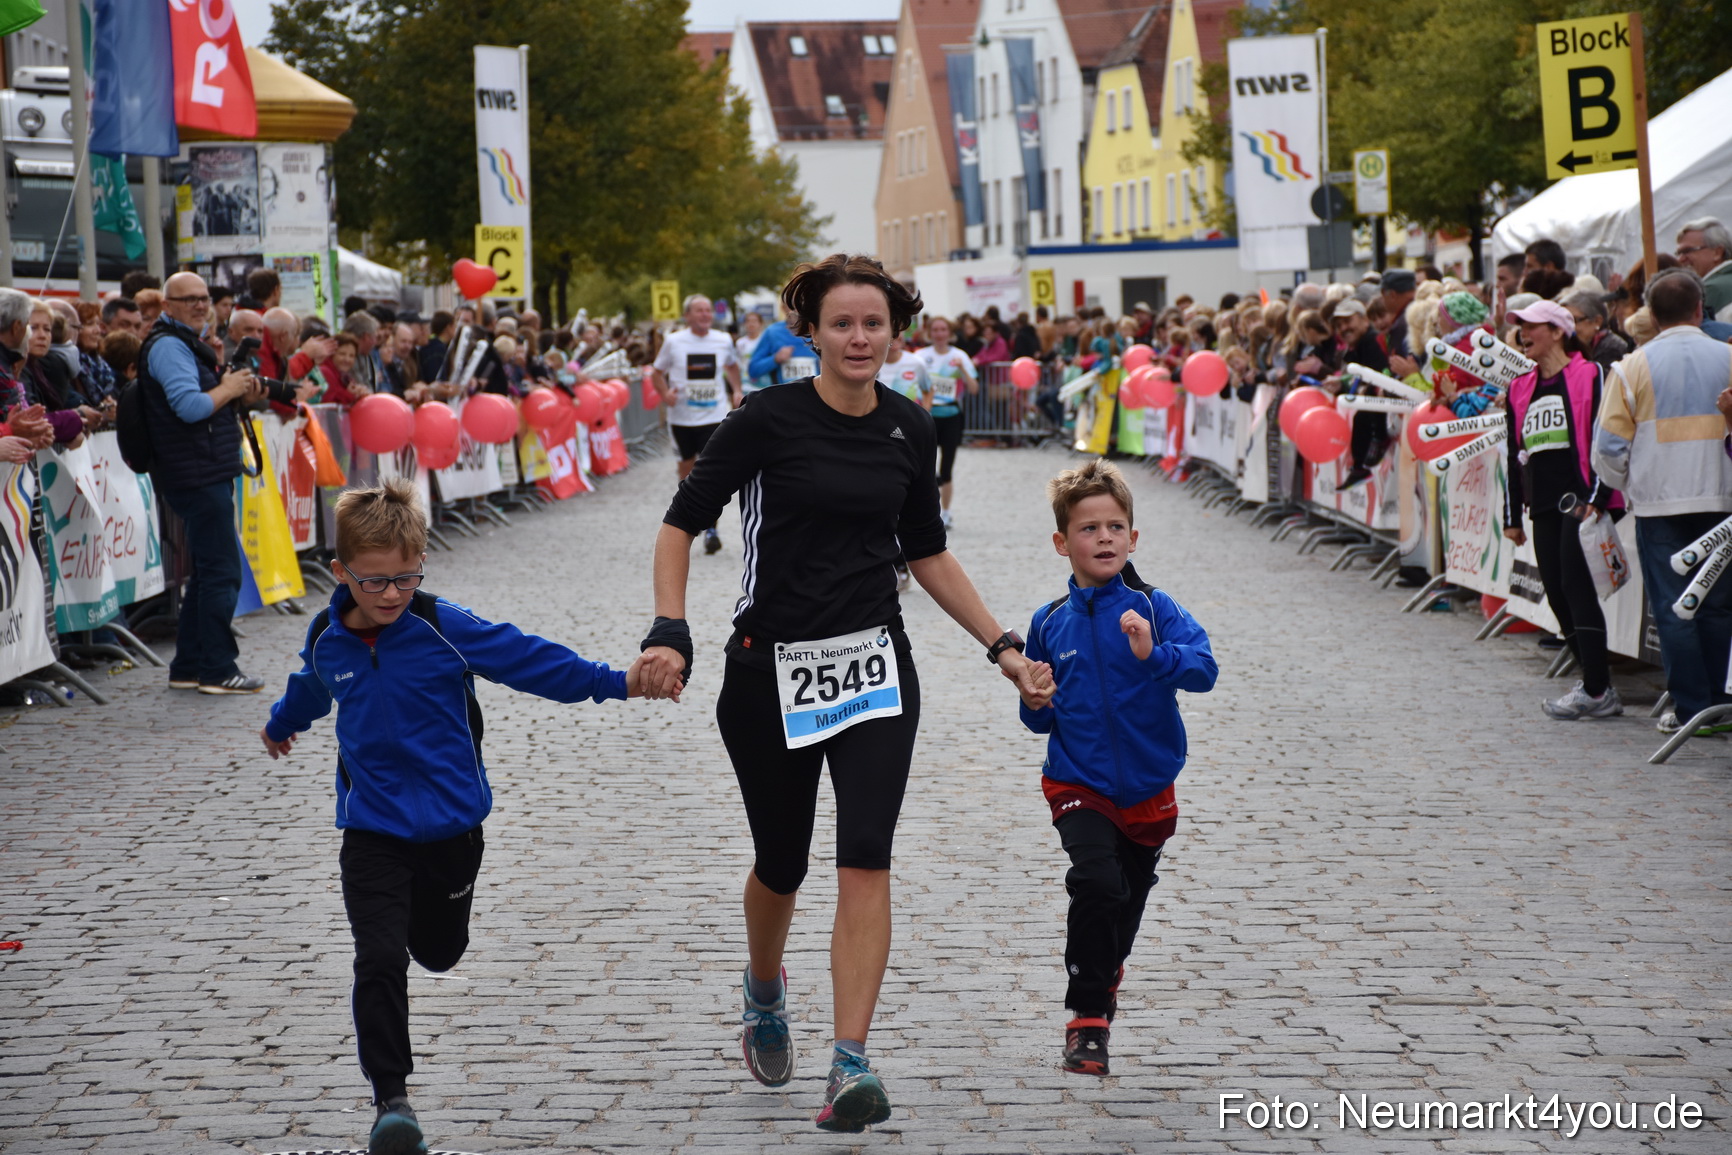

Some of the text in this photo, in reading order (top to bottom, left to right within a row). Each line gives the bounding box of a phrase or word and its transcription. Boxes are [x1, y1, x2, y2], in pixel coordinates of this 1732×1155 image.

[1550, 21, 1630, 56] Block
[1567, 65, 1621, 142] B
[481, 227, 518, 242] Block
[488, 247, 512, 281] C
[1036, 279, 1050, 299] D
[659, 292, 674, 312] D
[1447, 418, 1479, 434] BMW
[1525, 408, 1565, 435] 5105
[1455, 440, 1486, 462] BMW
[1699, 524, 1732, 554] BMW
[777, 641, 874, 663] PARTL Neumarkt
[790, 653, 887, 706] 2549
[815, 698, 870, 729] Martina
[449, 884, 472, 899] JAKO
